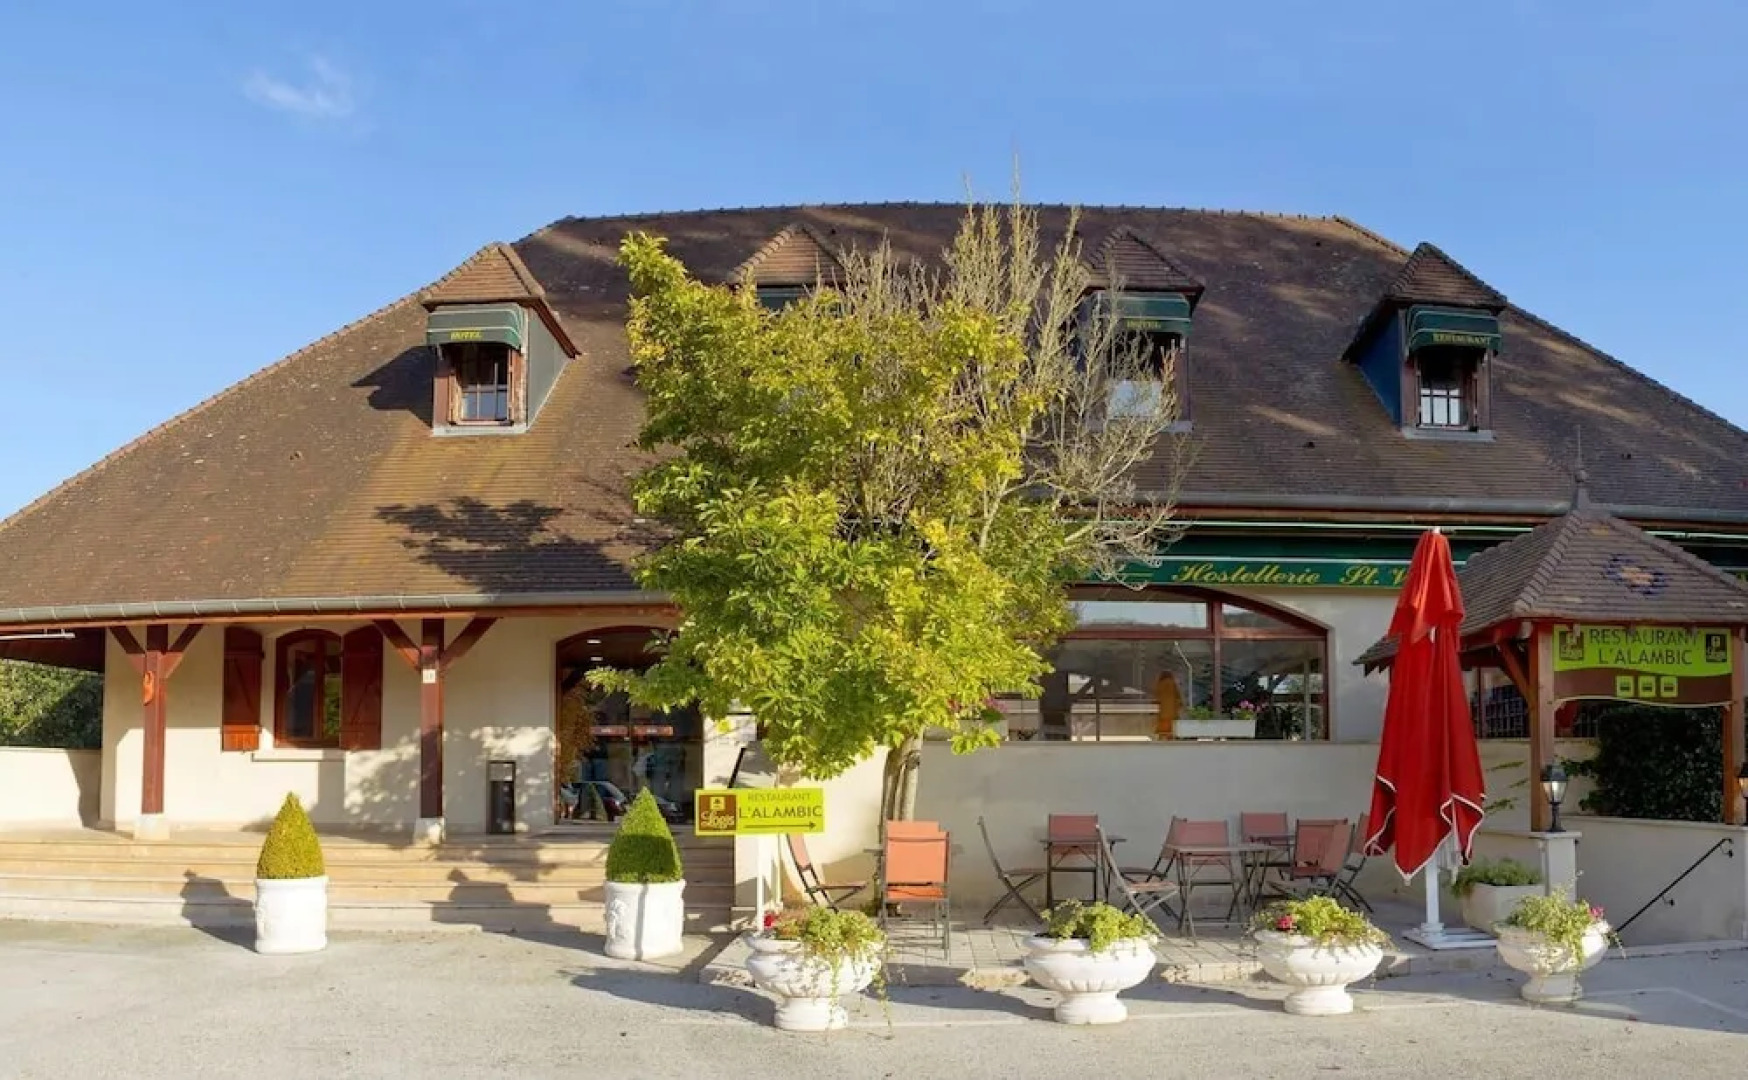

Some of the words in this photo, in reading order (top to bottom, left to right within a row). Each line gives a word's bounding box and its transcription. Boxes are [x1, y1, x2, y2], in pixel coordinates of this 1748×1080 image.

[1171, 562, 1320, 584] Hostellerie
[1589, 628, 1699, 646] RESTAURANT
[1598, 648, 1693, 665] L'ALAMBIC
[747, 792, 811, 802] RESTAURANT
[738, 805, 823, 819] L'ALAMBIC
